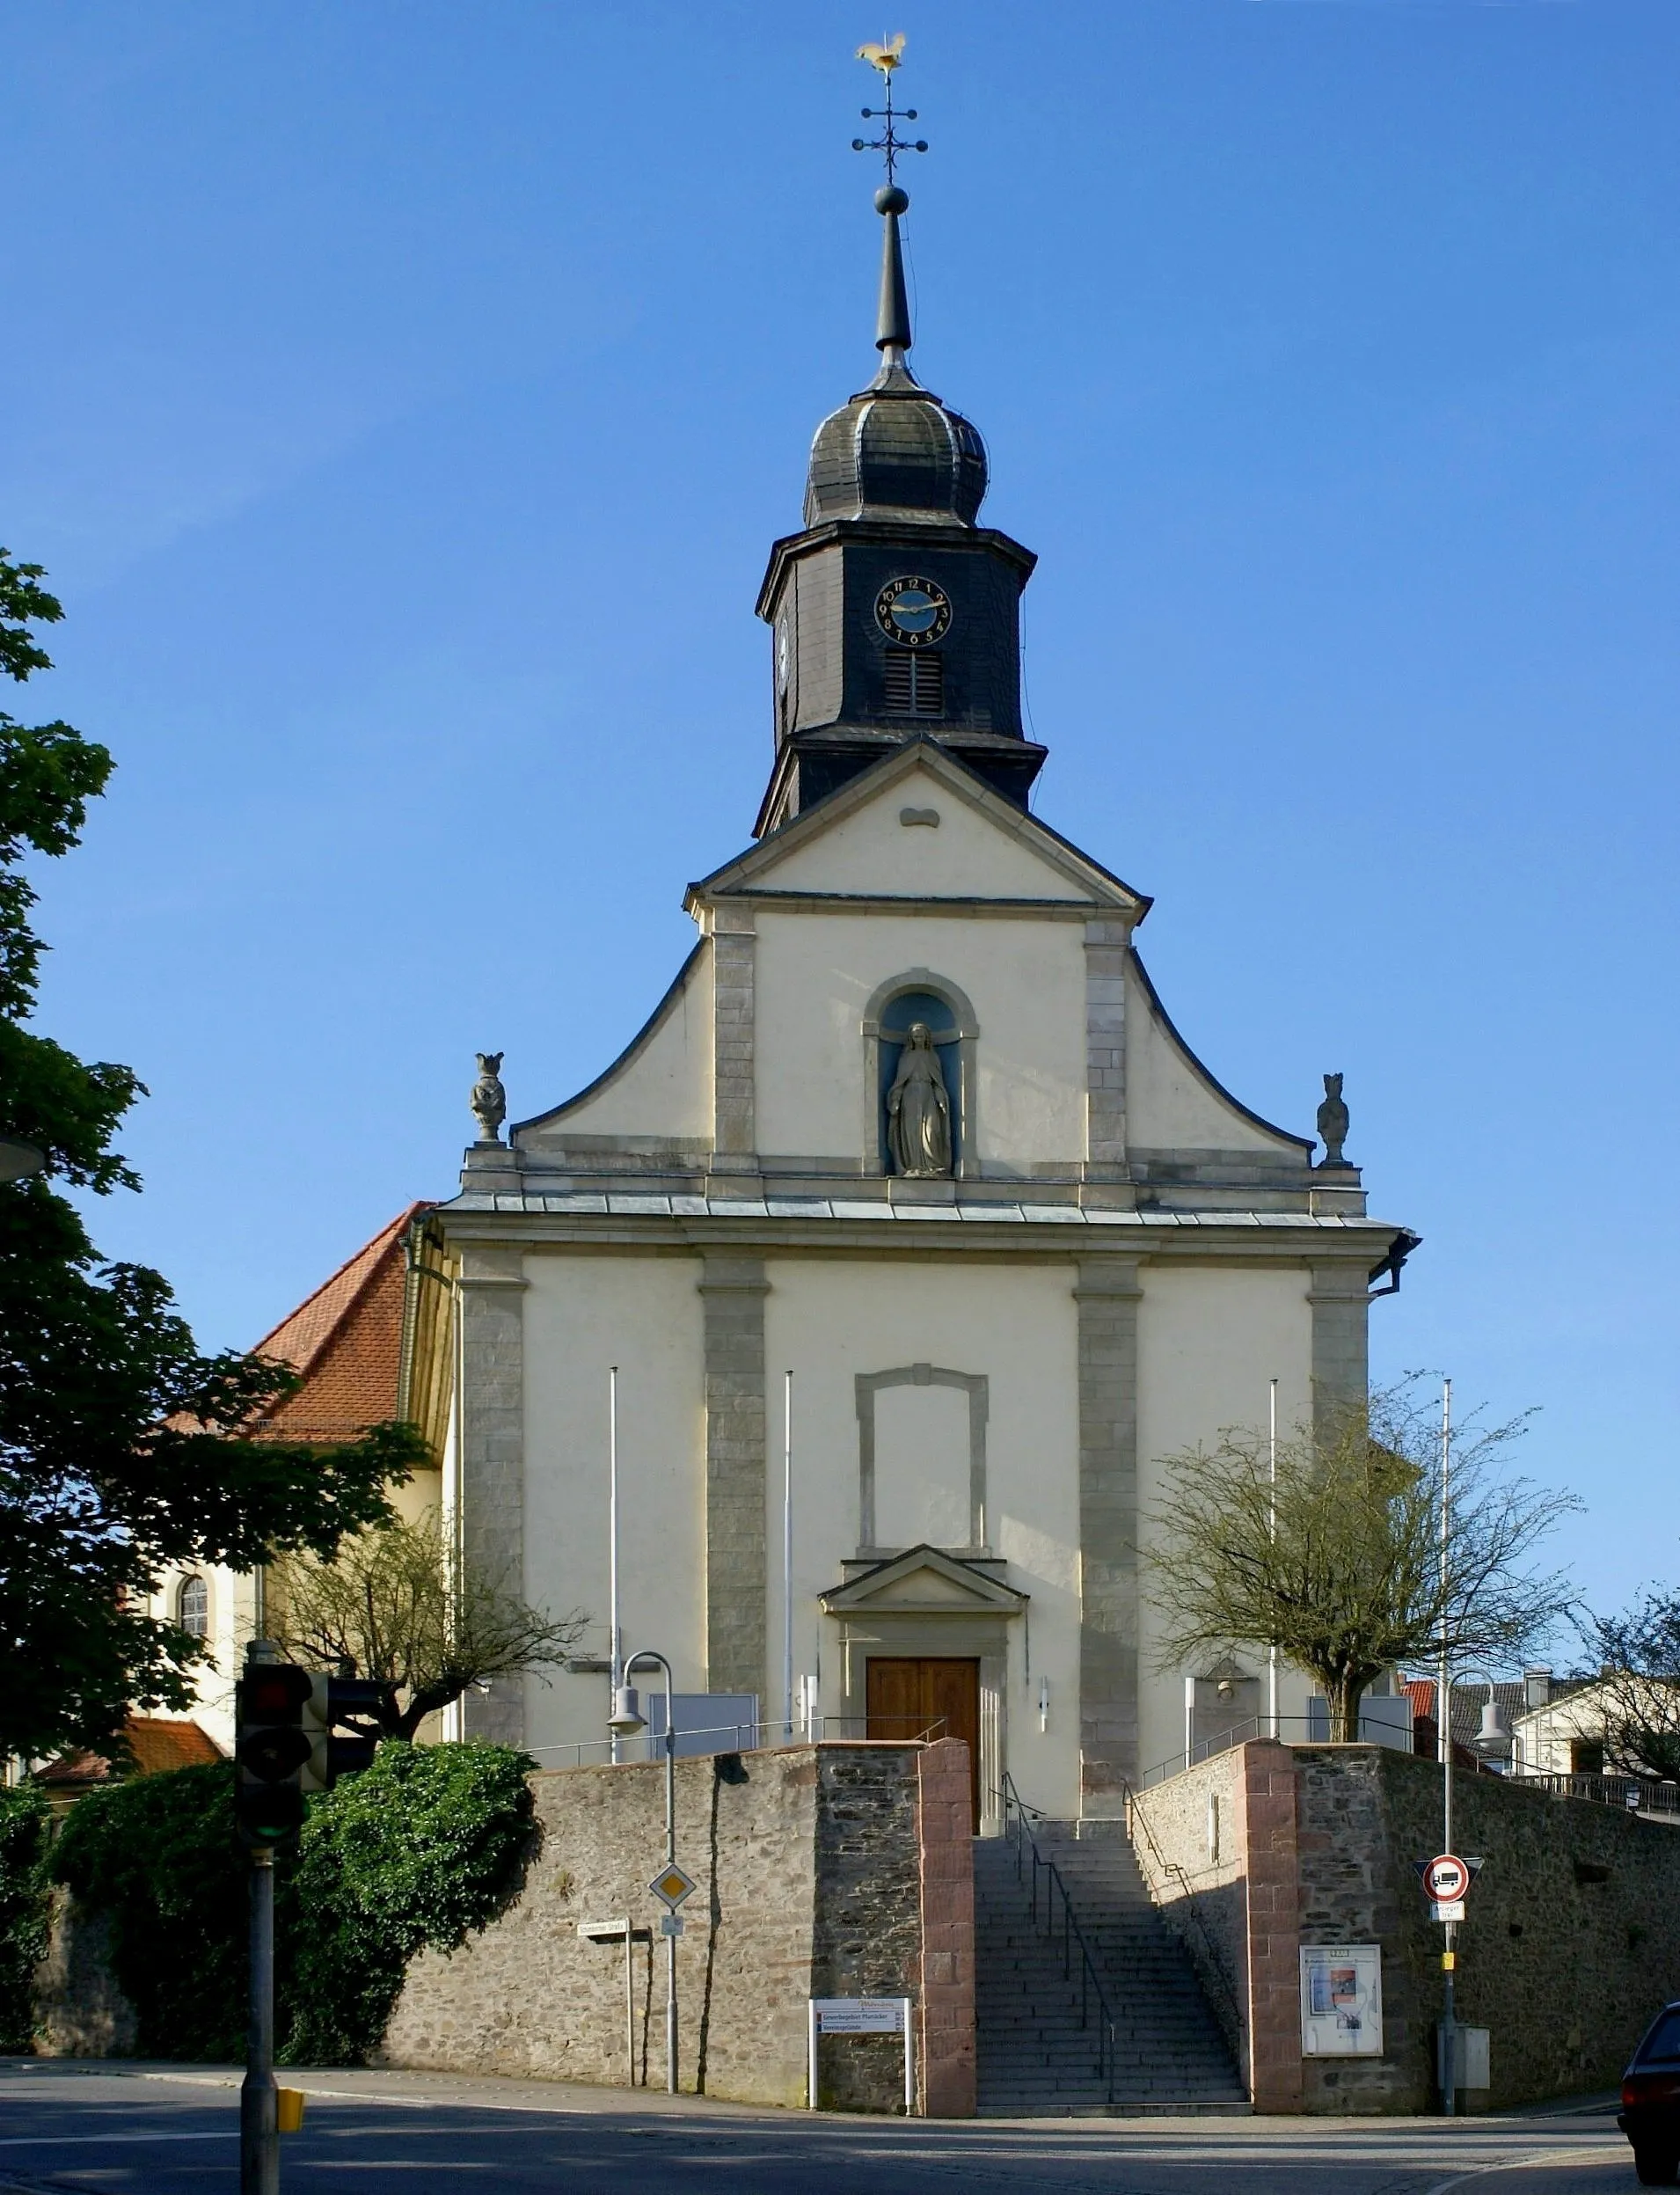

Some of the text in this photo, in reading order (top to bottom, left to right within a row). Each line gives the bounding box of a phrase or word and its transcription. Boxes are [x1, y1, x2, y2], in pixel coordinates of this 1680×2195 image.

[895, 582, 902, 591] 11
[909, 578, 918, 589] 12
[926, 583, 931, 593] 1
[882, 591, 895, 602] 10
[936, 593, 944, 602] 2
[879, 604, 887, 616] 9
[942, 607, 948, 618] 3
[884, 618, 892, 629] 8
[936, 620, 944, 632] 4
[896, 630, 902, 640] 7
[909, 633, 918, 644] 6
[925, 631, 932, 641] 5
